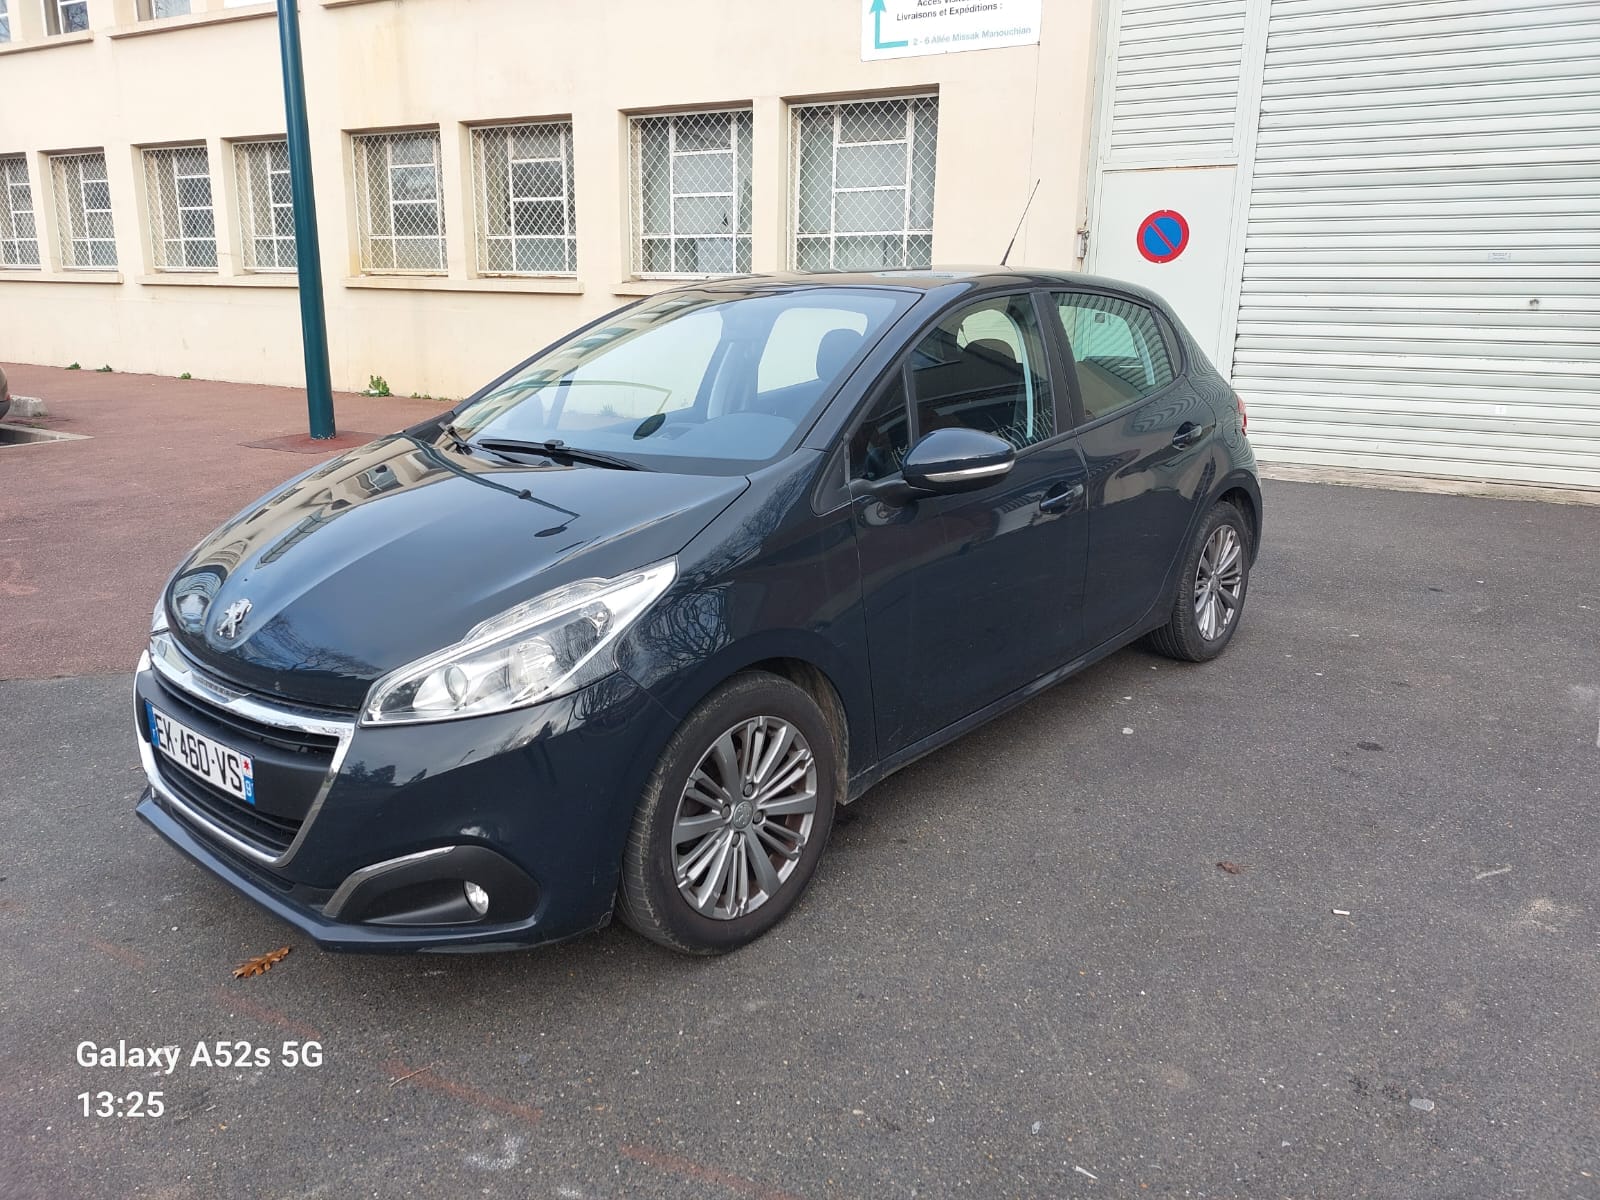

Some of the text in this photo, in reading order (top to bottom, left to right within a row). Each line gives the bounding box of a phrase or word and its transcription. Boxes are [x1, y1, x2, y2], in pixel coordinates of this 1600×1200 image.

[896, 11, 937, 21] Livraisons
[949, 3, 998, 16] Expéditions
[912, 38, 918, 46] 2
[931, 35, 951, 44] Allée
[952, 32, 979, 42] Missak
[981, 27, 1031, 38] Manouchian
